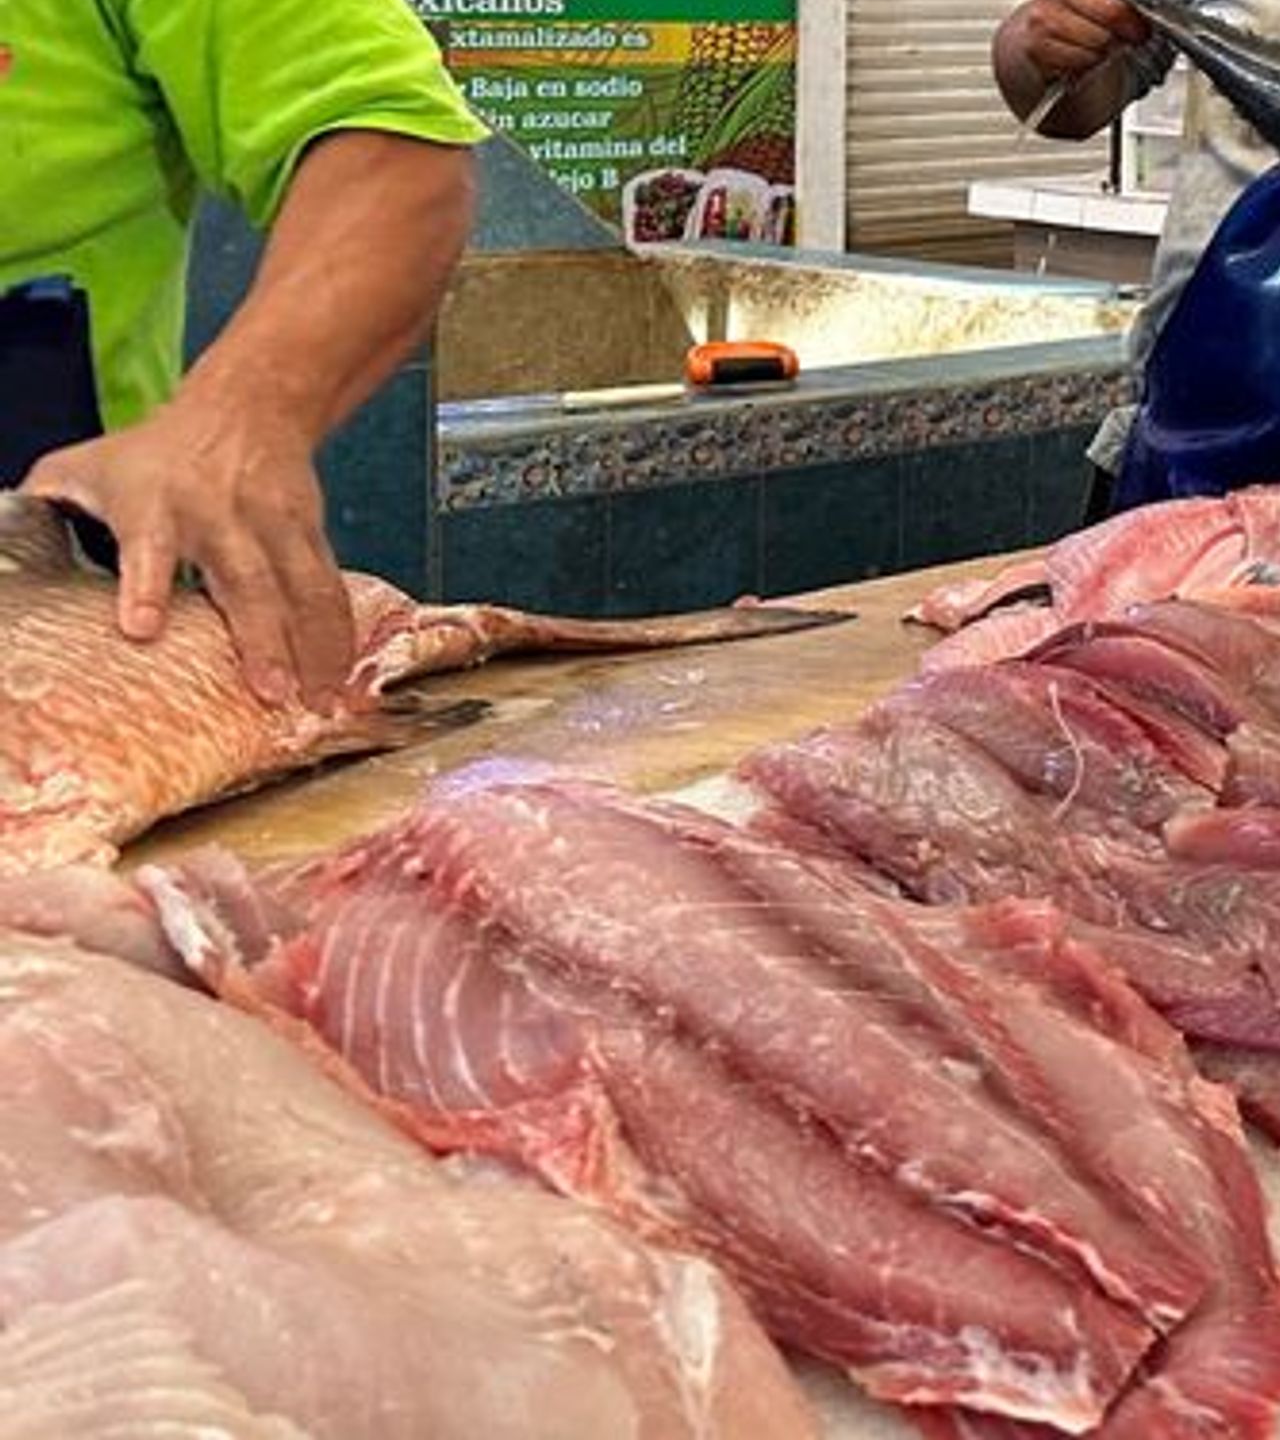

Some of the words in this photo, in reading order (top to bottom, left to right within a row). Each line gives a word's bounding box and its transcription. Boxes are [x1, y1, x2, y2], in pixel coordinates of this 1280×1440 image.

[449, 26, 616, 49] xtamalizado
[471, 77, 529, 101] Baja
[537, 82, 567, 97] en
[574, 75, 644, 98] sodio
[529, 138, 643, 160] vitamina
[649, 135, 688, 156] del
